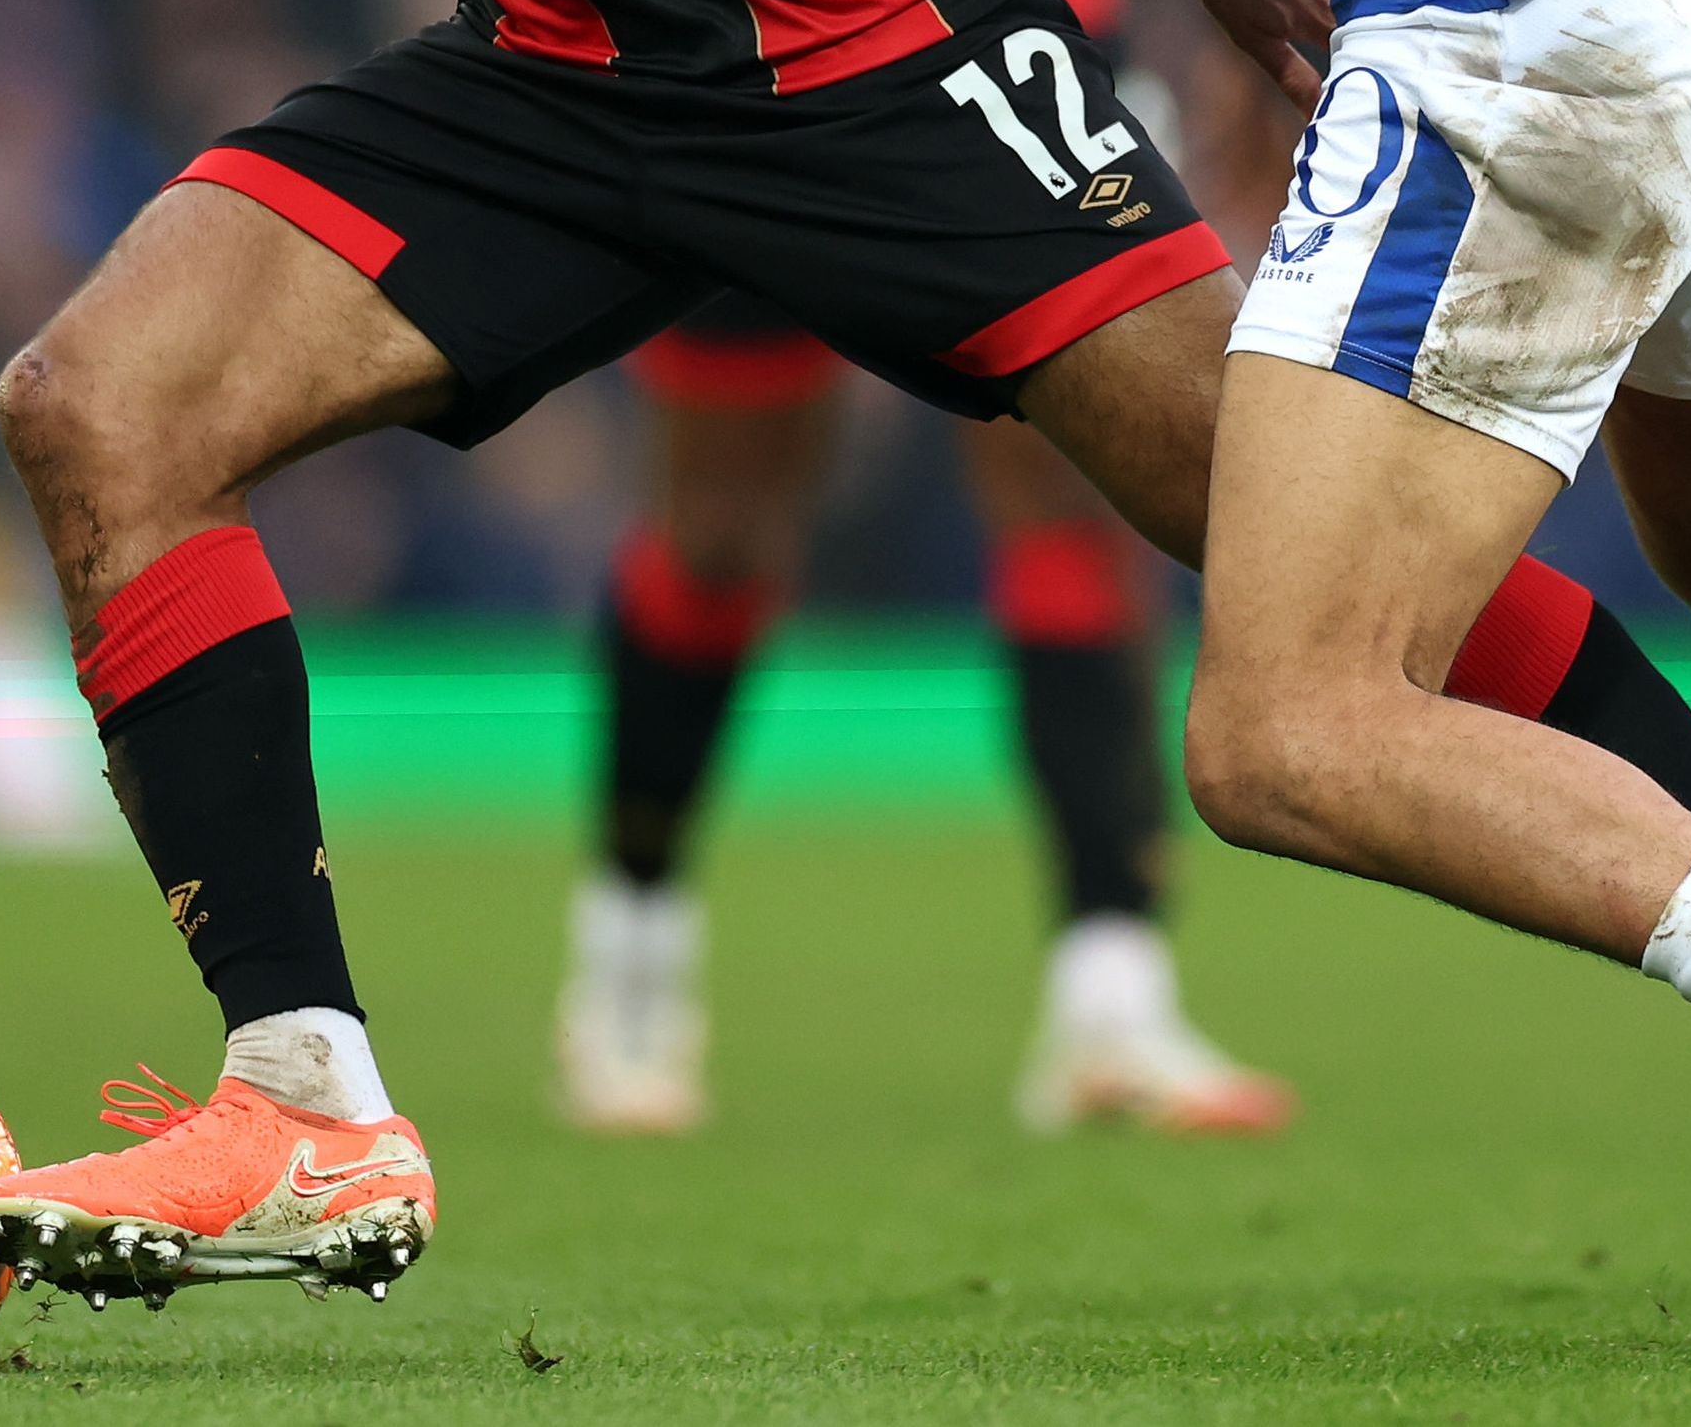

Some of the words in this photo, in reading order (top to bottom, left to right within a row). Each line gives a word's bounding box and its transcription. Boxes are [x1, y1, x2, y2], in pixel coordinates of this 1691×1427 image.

[939, 27, 1139, 200] 12
[1106, 201, 1152, 228] umbro
[184, 911, 209, 940] bro
